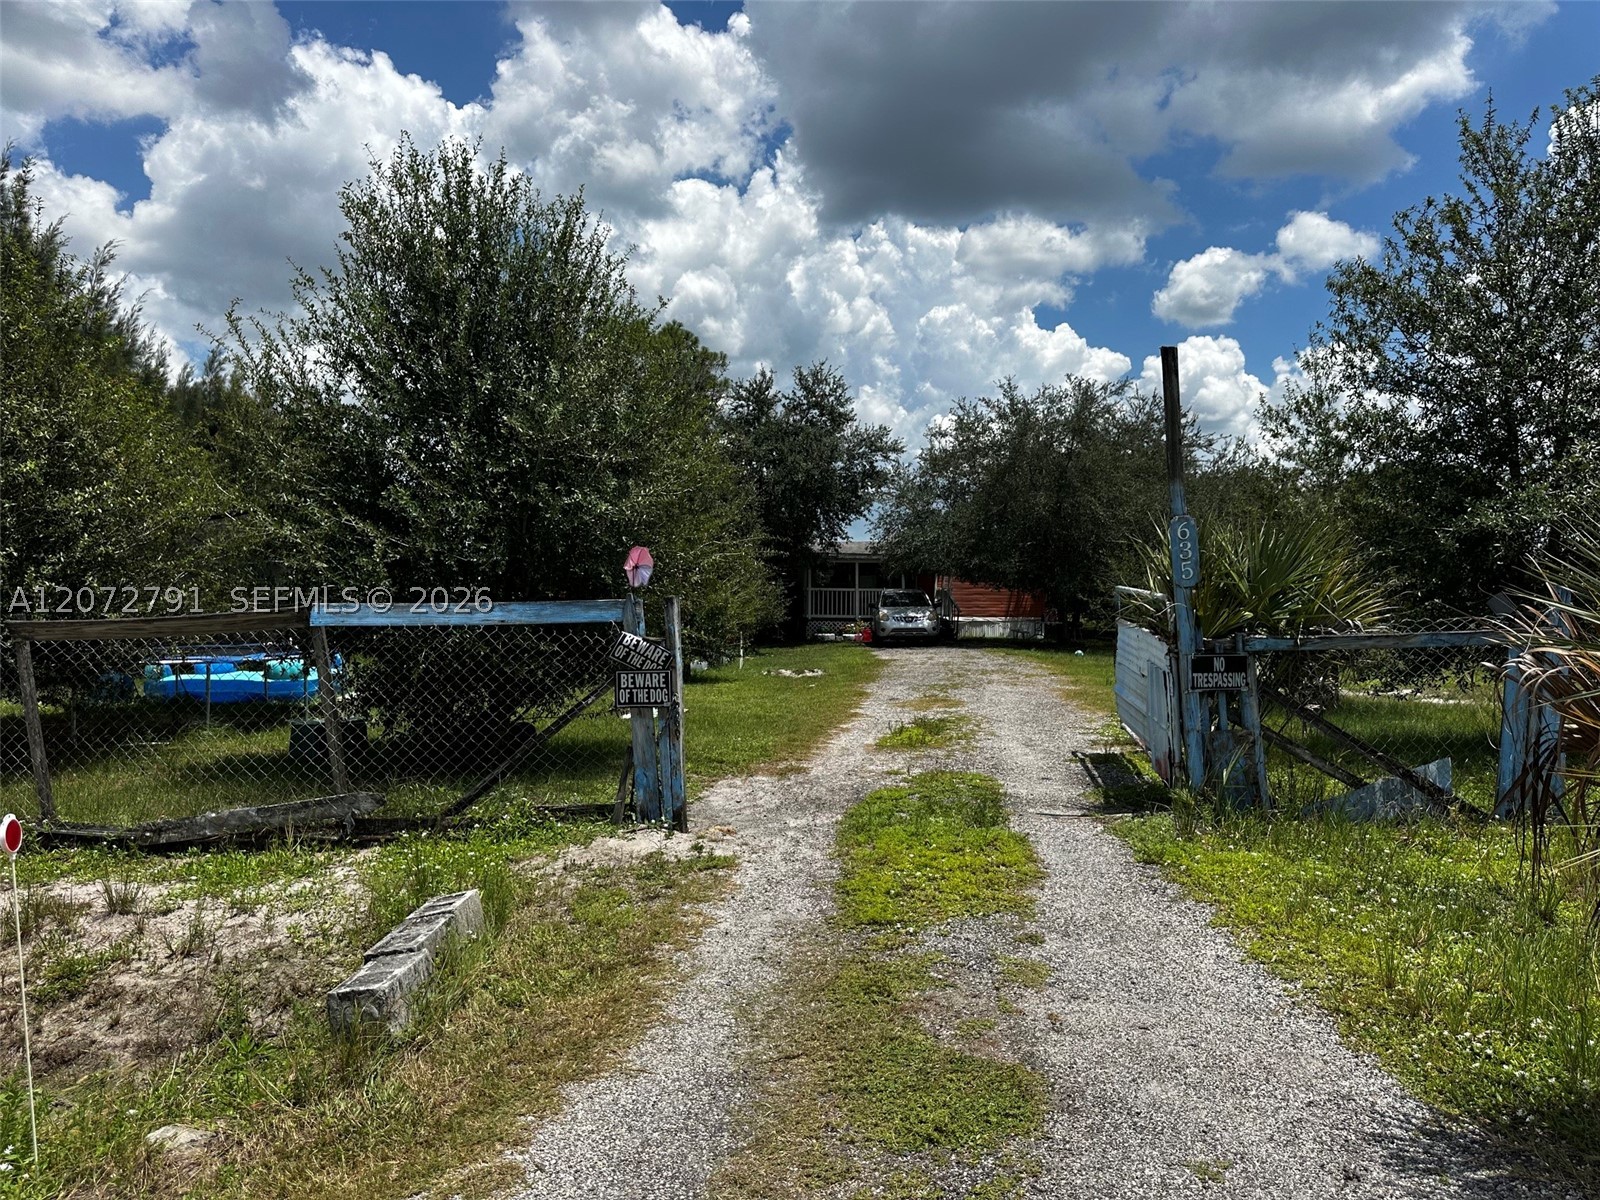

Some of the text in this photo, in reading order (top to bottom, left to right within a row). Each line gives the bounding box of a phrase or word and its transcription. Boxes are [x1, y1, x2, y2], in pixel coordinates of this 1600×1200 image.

[1177, 521, 1194, 580] 635
[614, 645, 629, 659] OF
[626, 651, 646, 668] THE
[622, 634, 669, 665] BEWARE
[1213, 656, 1226, 671] NO
[620, 673, 666, 688] BEWARE
[1192, 672, 1246, 688] TRESPASSING
[619, 688, 668, 703] OF THE DOG
